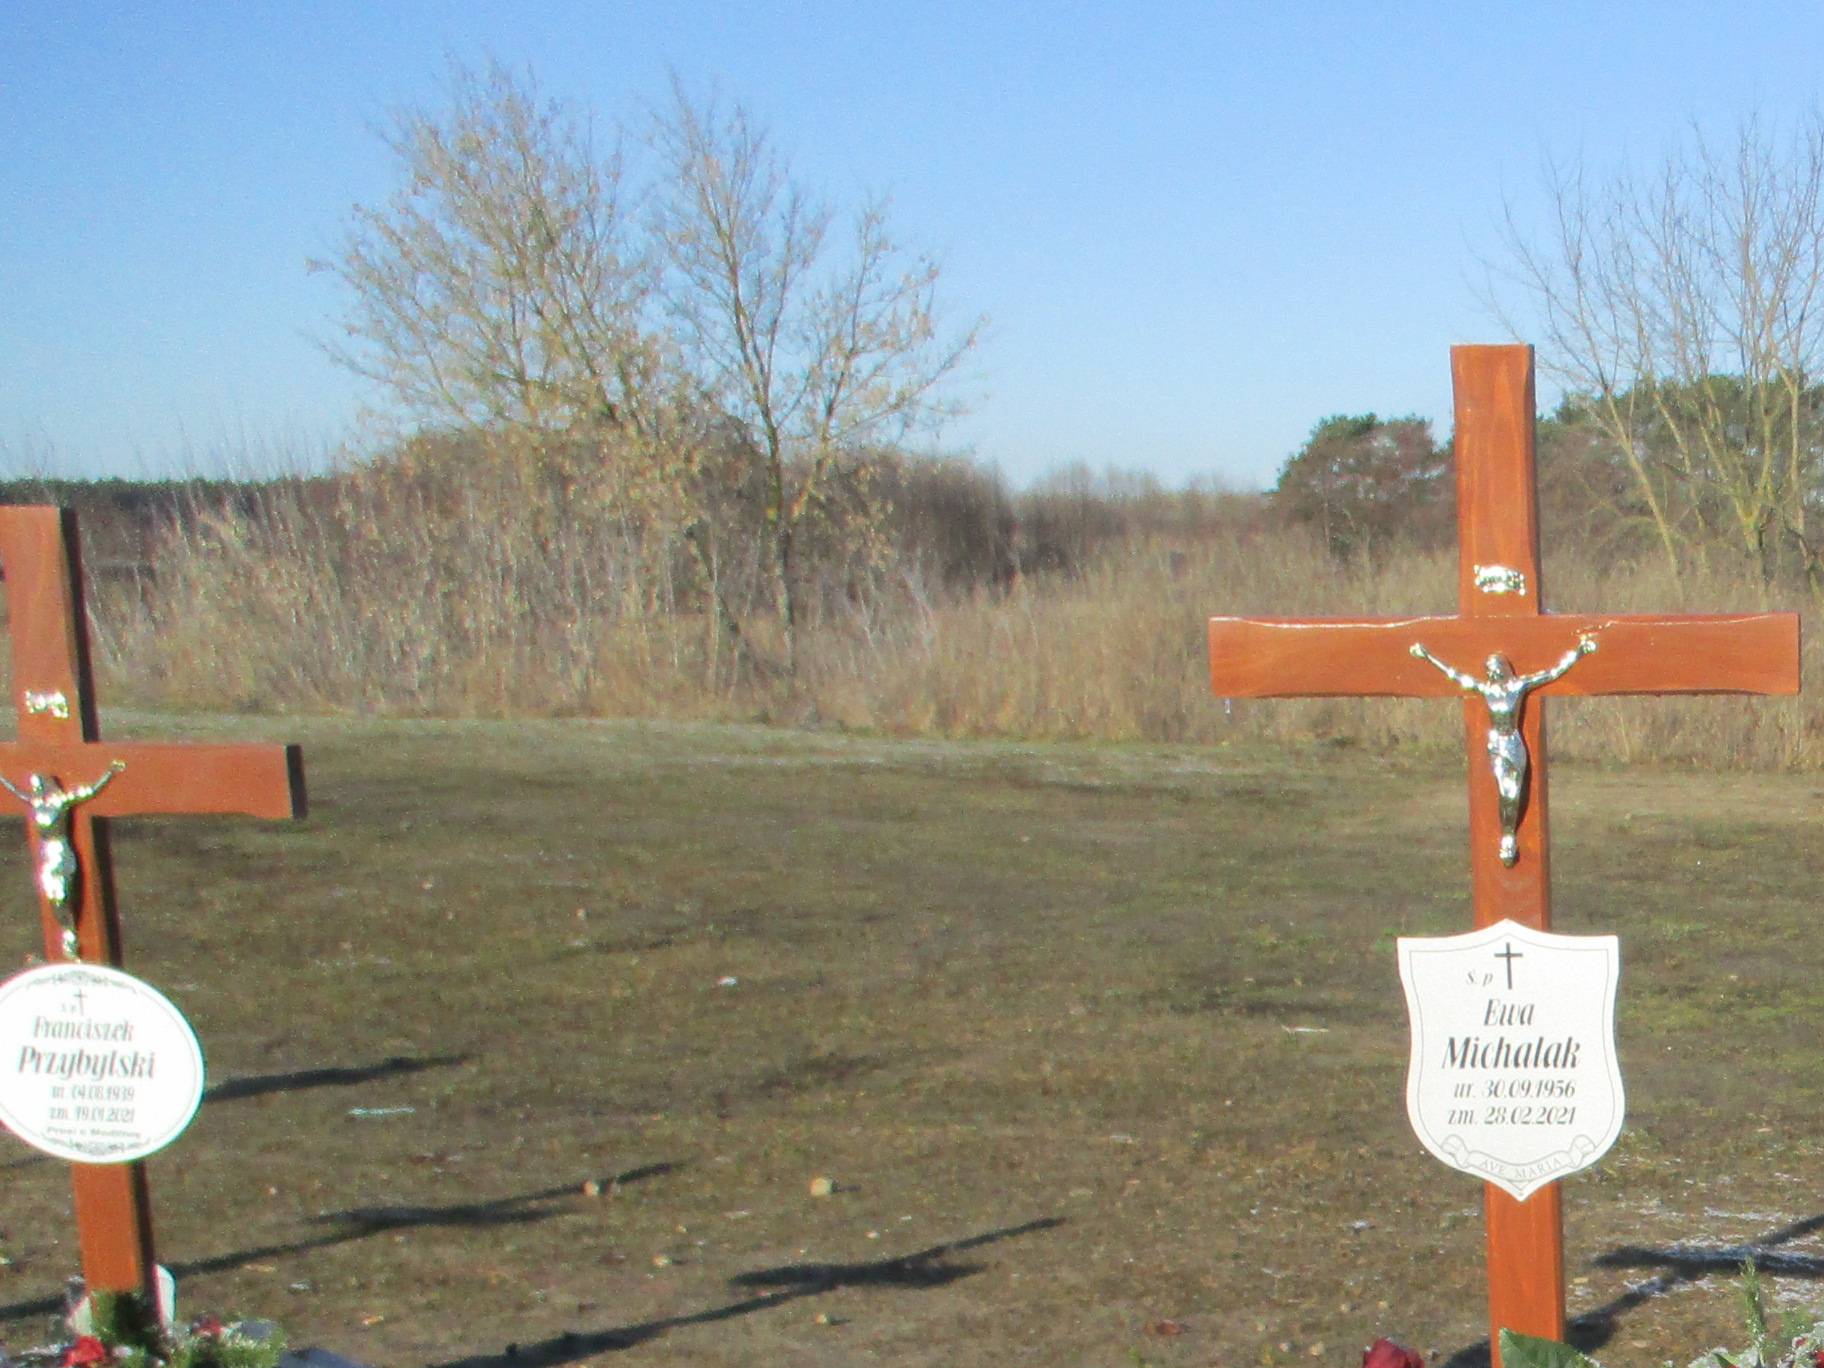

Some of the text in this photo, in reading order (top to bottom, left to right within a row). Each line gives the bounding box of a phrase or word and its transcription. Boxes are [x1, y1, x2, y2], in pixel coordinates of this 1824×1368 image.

[1483, 998, 1535, 1026] Ewa
[33, 1015, 134, 1042] Franciszek
[17, 1045, 156, 1082] Przybylski
[1442, 1036, 1581, 1069] Michalak
[1454, 1079, 1576, 1099] ur. 30.09.1956
[1448, 1106, 1576, 1125] zm. 28.02.2021
[1479, 1157, 1562, 1178] AVE MARIA
